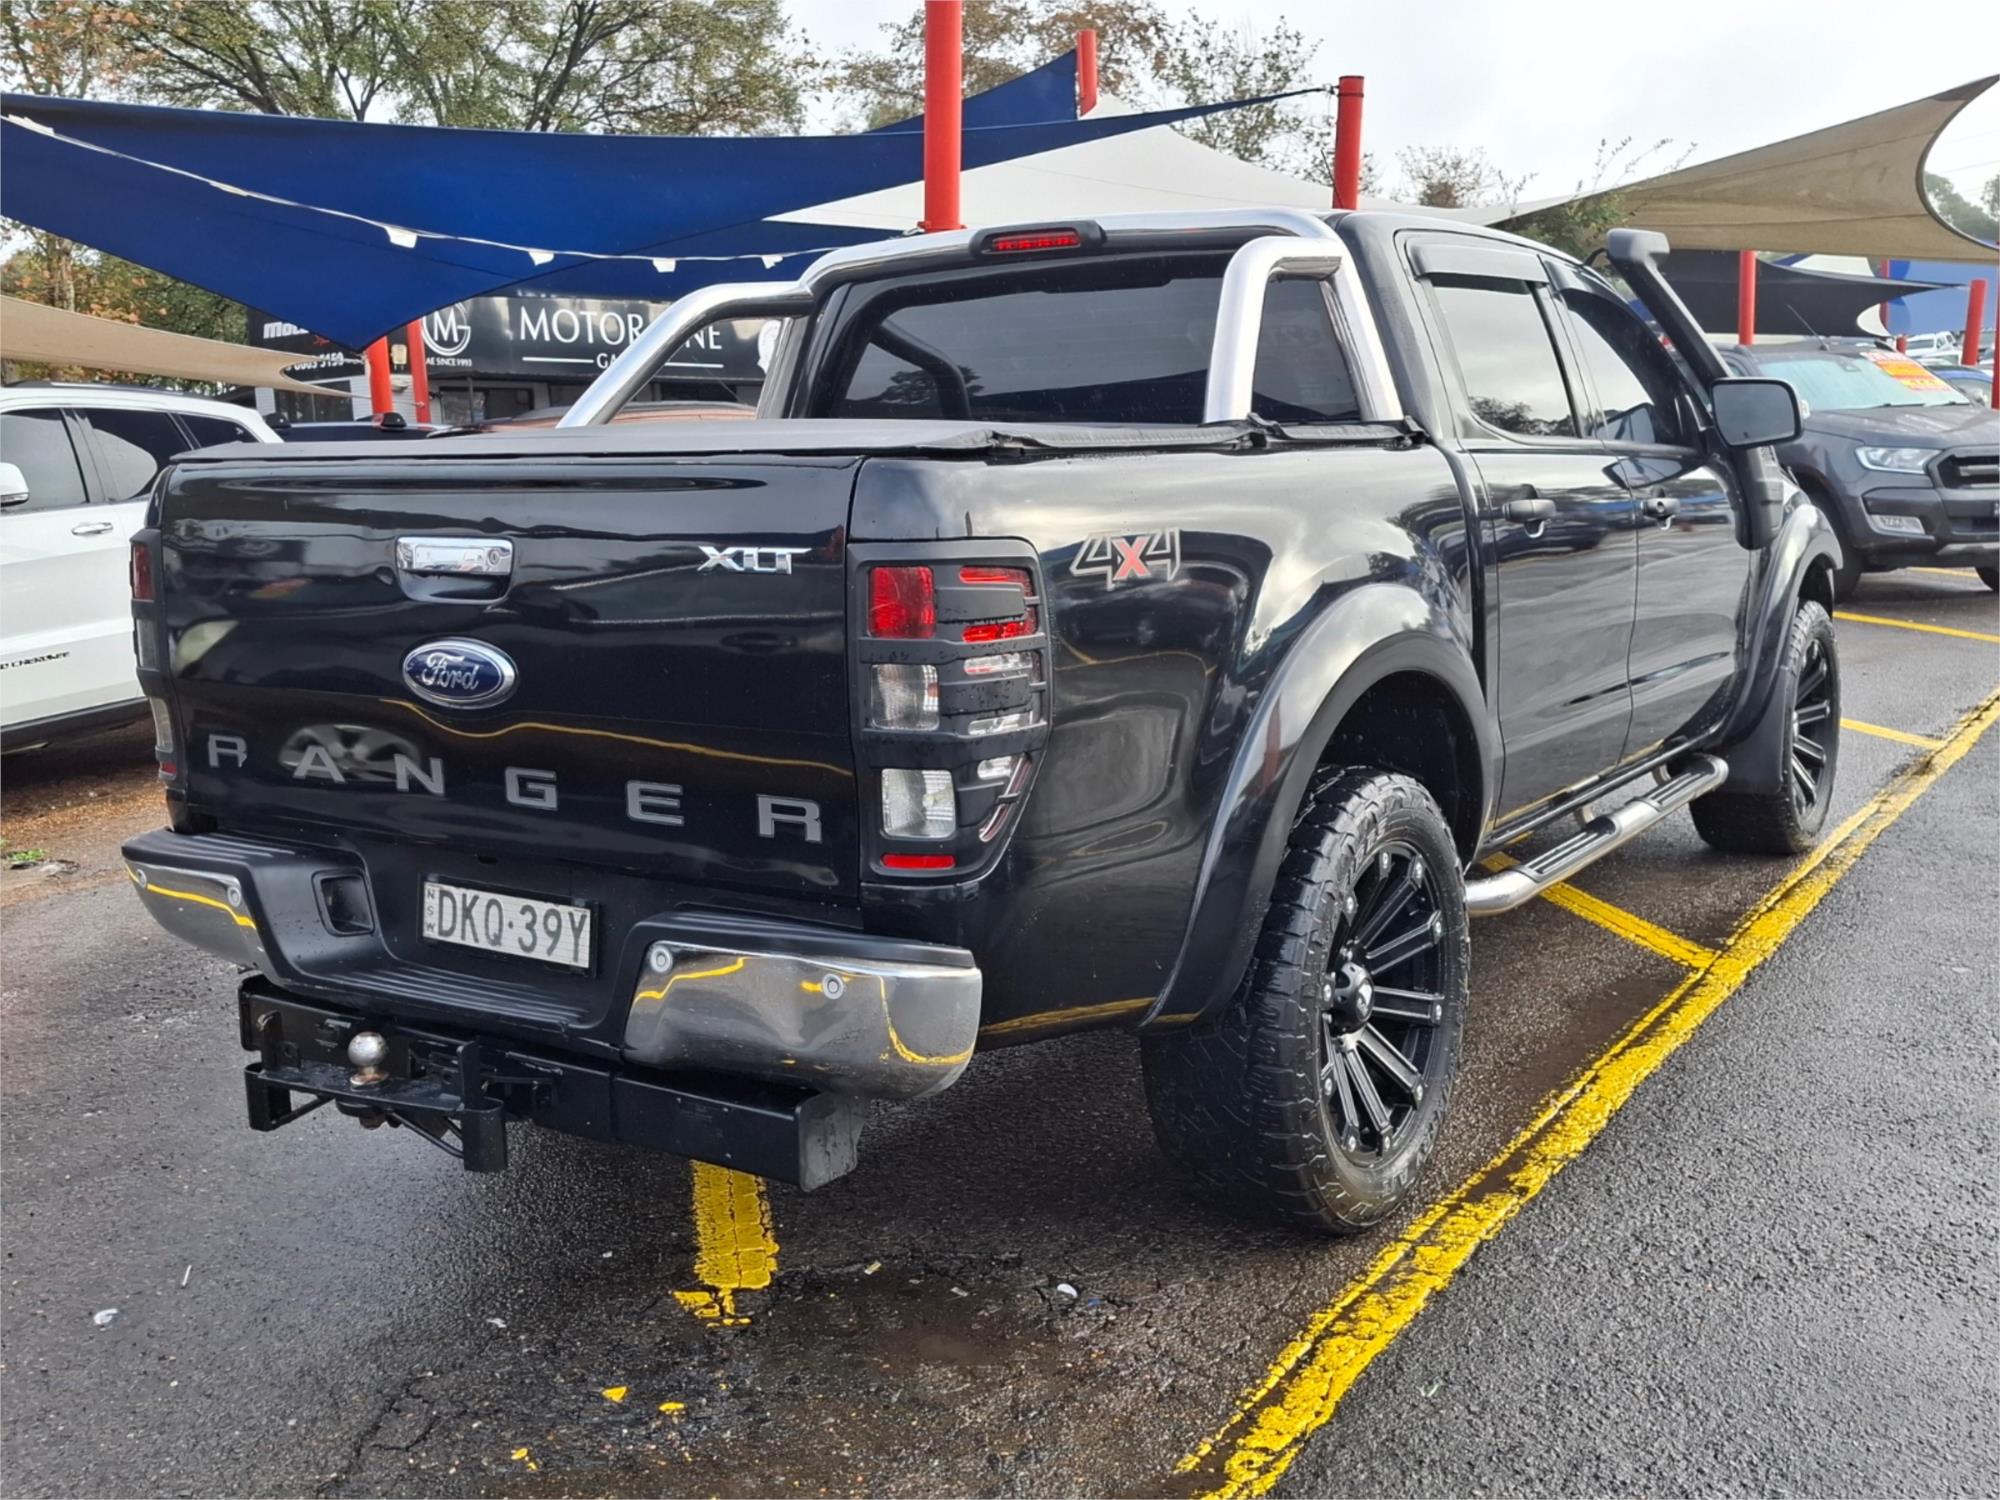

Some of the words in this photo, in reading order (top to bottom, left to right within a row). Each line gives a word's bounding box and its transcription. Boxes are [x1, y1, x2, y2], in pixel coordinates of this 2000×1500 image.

[697, 546, 813, 575] XLT
[421, 651, 481, 691] Ford
[207, 733, 823, 844] RANGER
